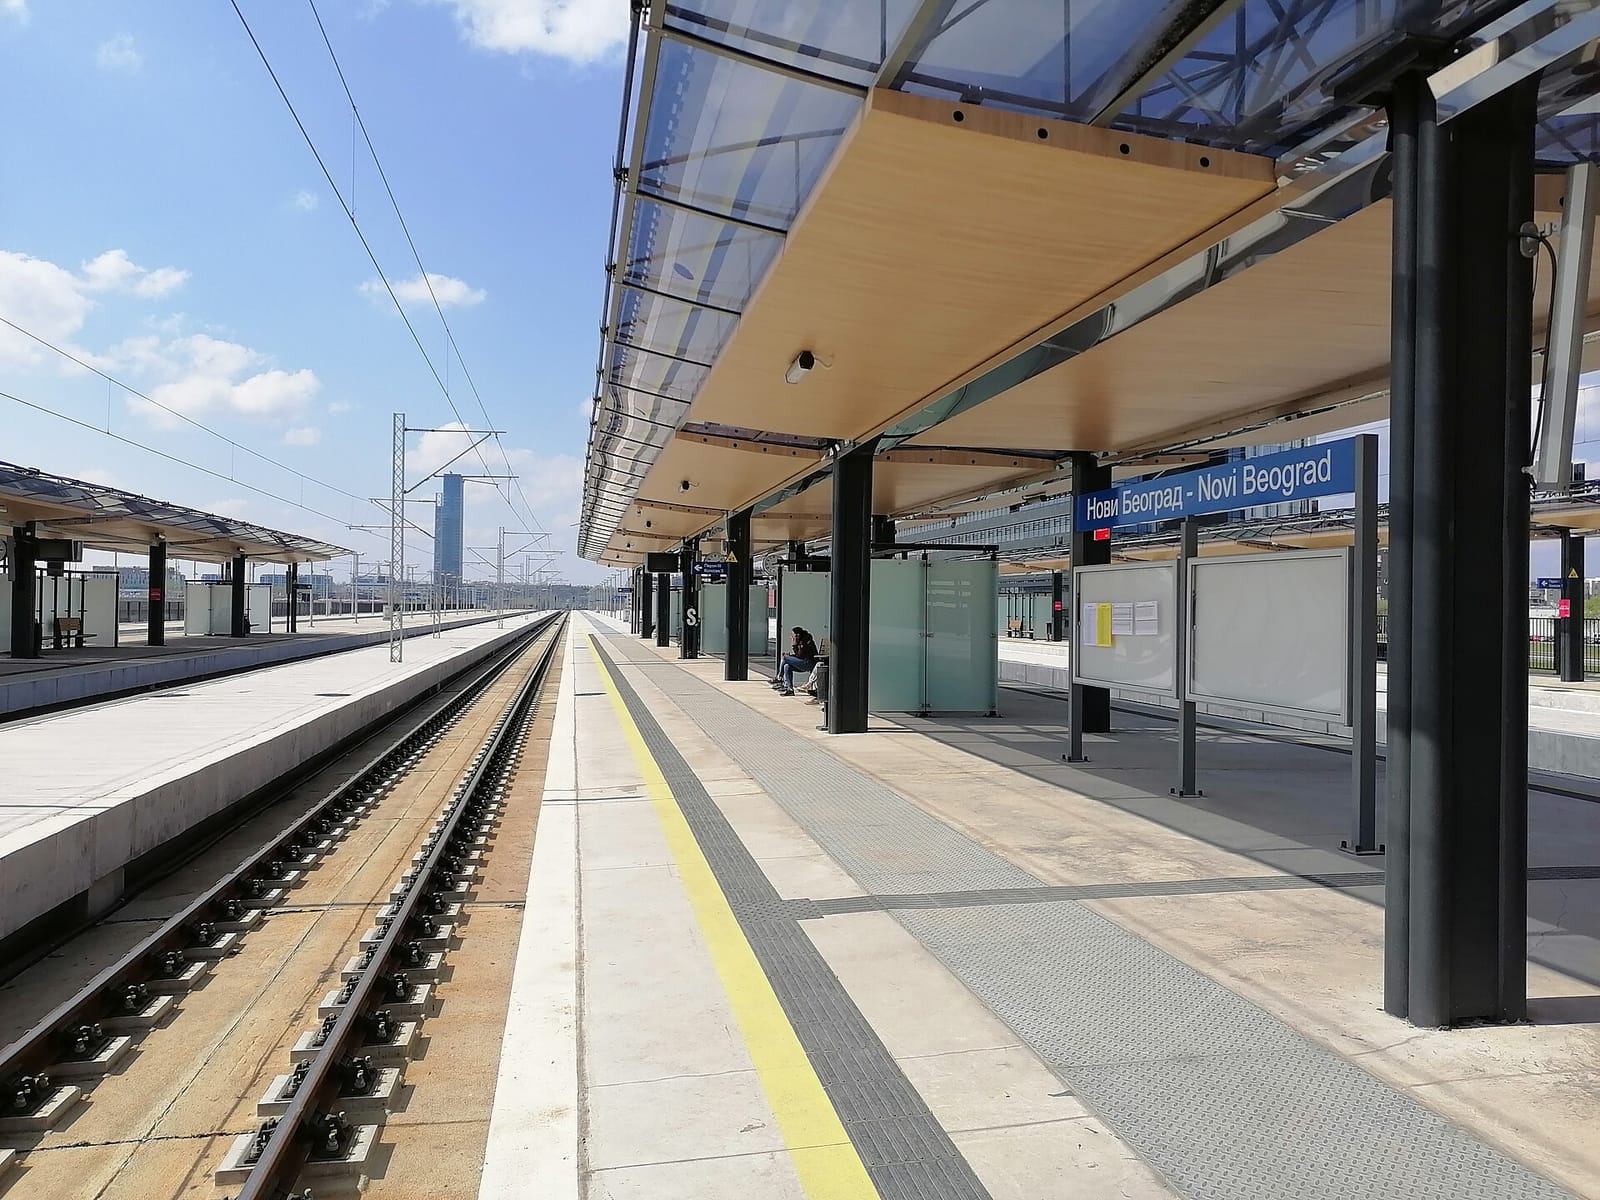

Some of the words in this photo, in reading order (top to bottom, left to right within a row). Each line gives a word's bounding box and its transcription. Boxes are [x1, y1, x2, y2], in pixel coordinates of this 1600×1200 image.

[1086, 497, 1119, 521] Нови
[1122, 485, 1183, 515] Београд
[1198, 468, 1237, 502] Novi
[1243, 448, 1331, 495] Beograd
